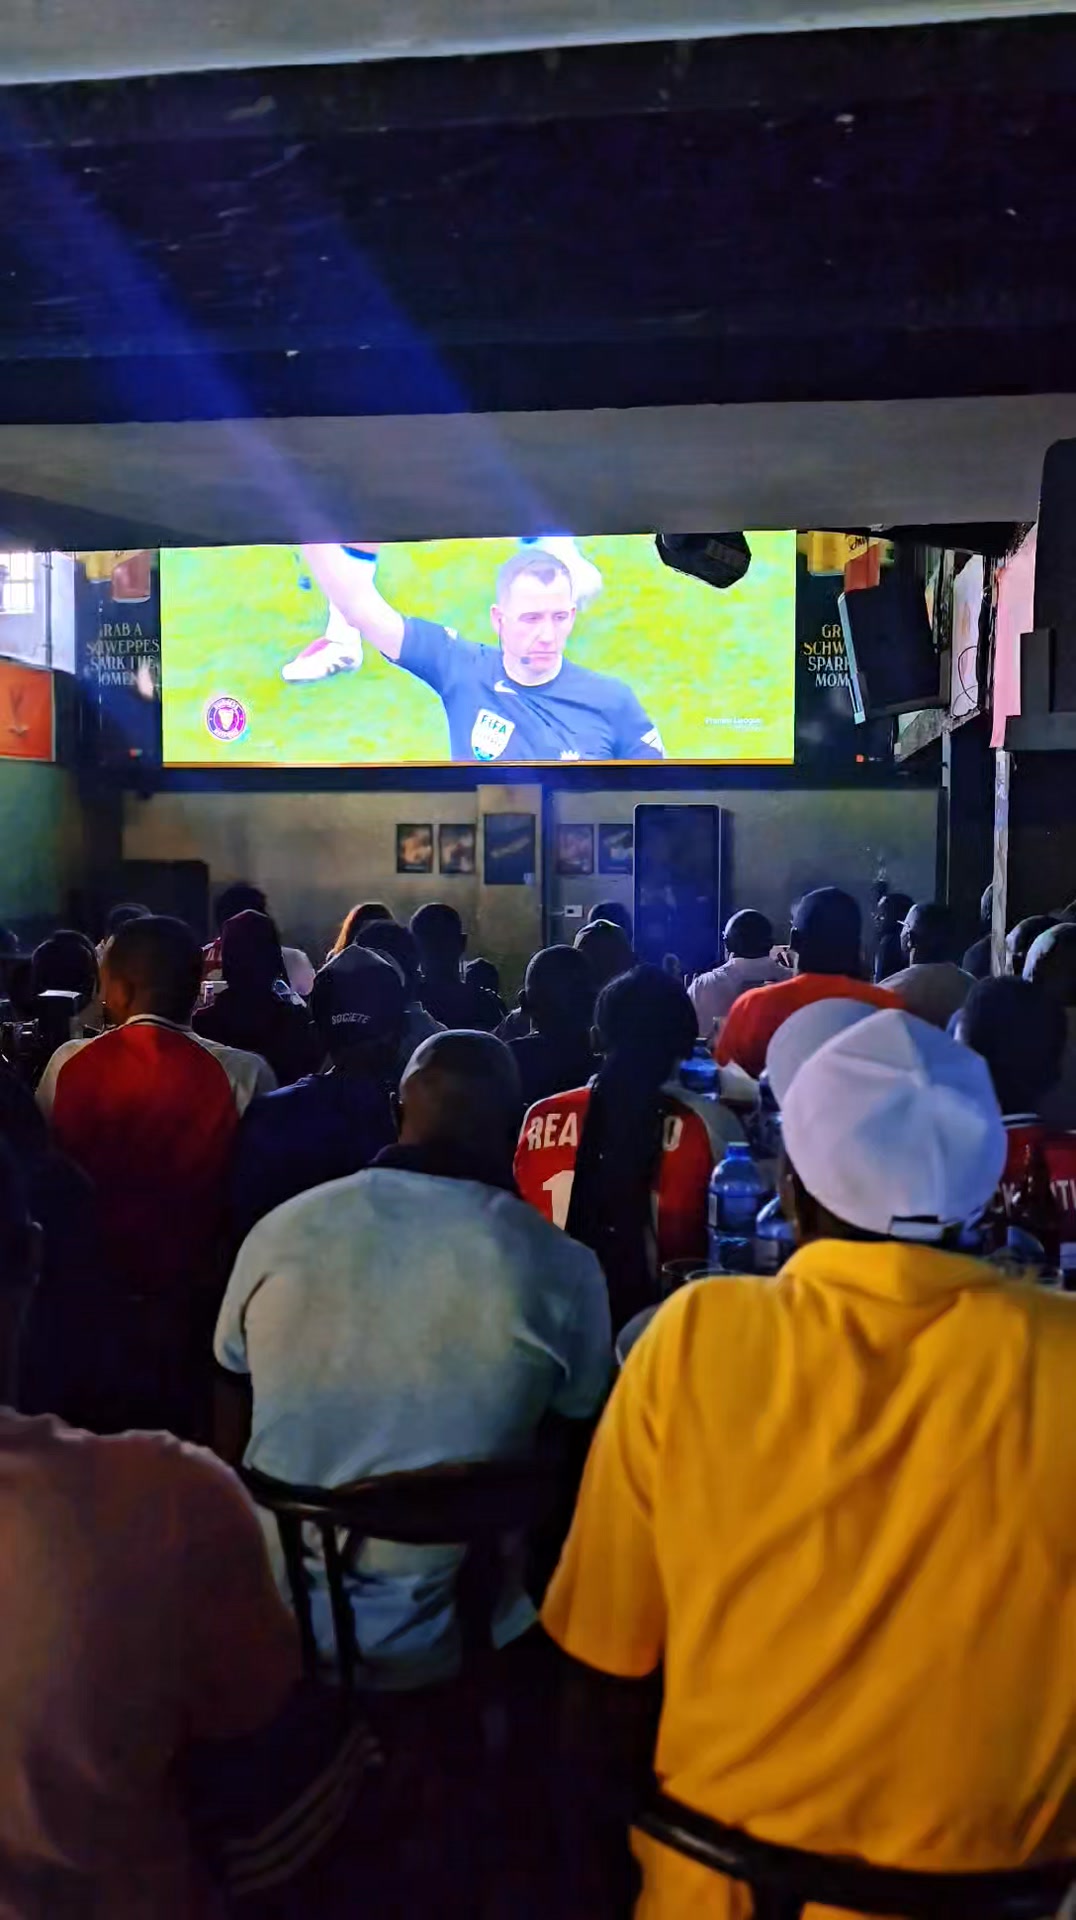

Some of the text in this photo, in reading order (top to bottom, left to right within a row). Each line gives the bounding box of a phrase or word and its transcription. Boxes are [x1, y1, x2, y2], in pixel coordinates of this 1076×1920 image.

[134, 622, 143, 636] A
[821, 624, 841, 638] GR
[803, 641, 845, 655] SCHW
[815, 673, 849, 687] MOM
